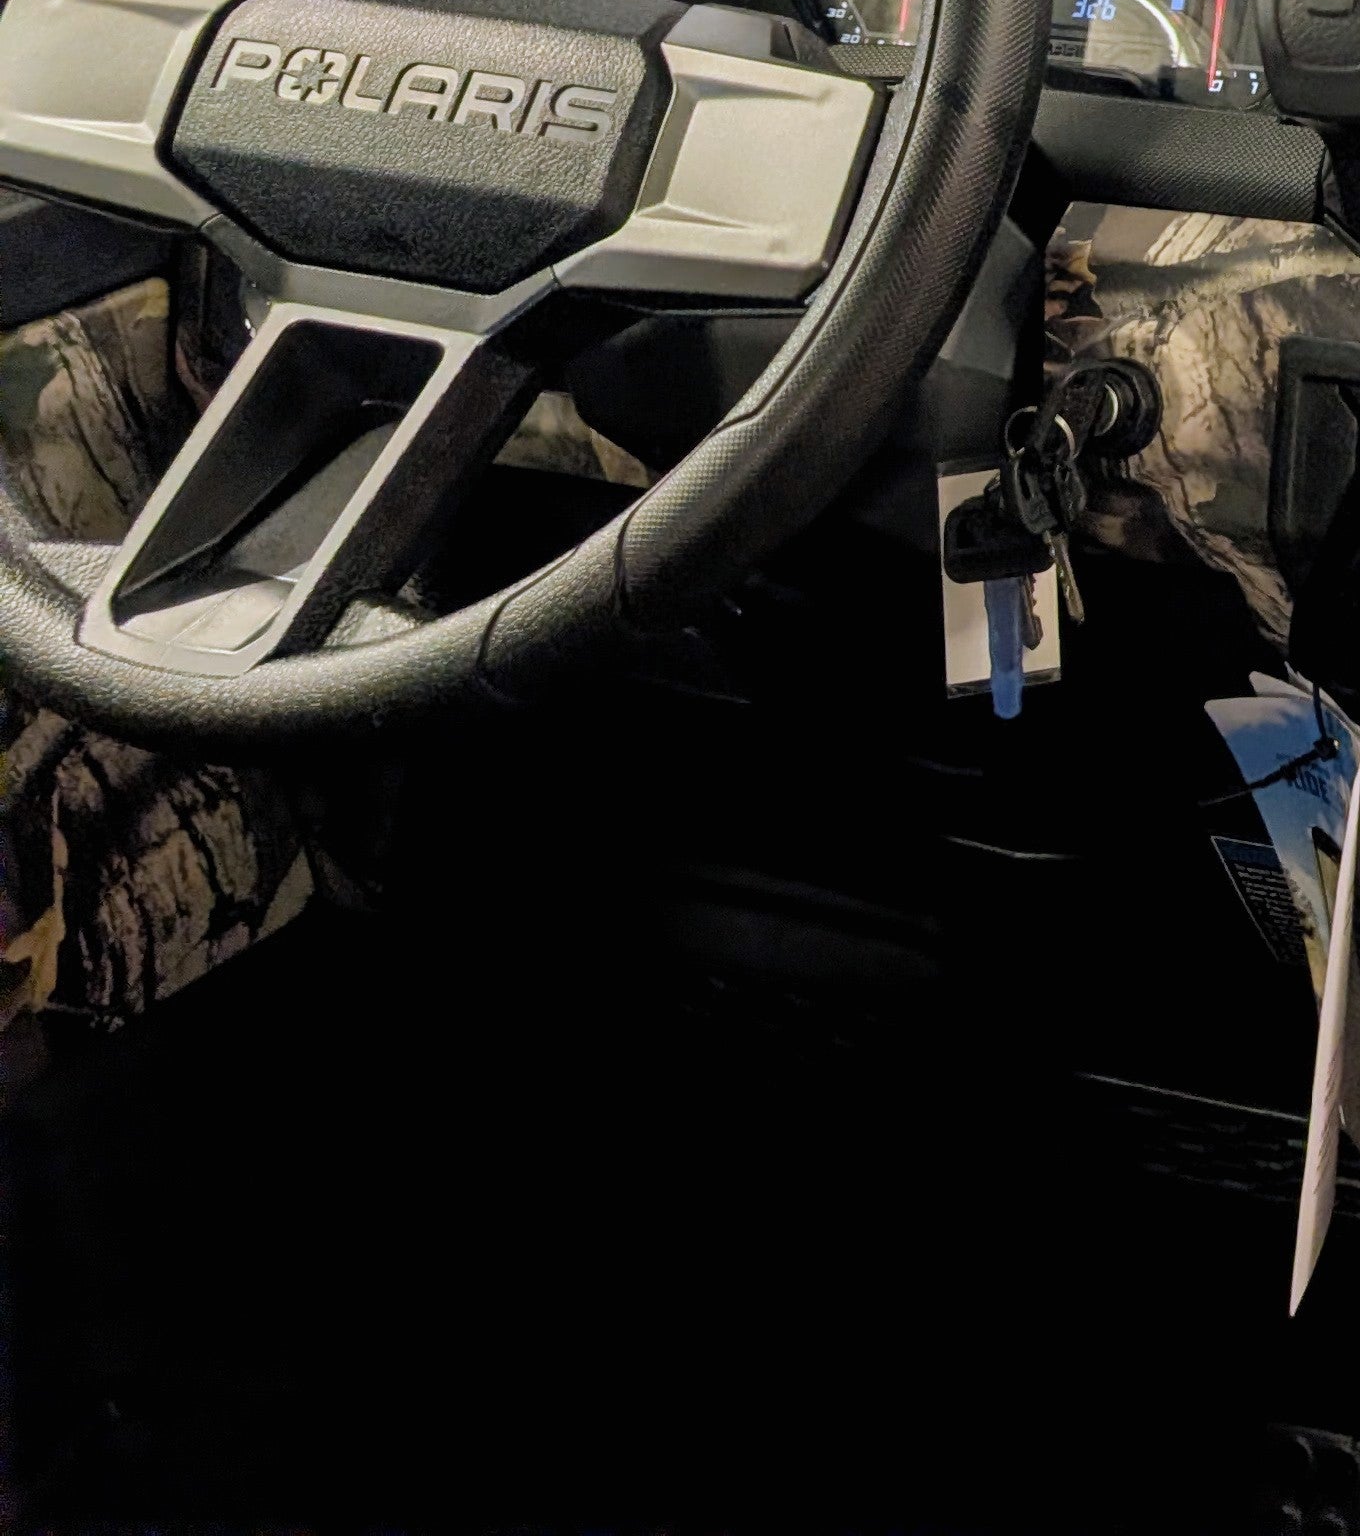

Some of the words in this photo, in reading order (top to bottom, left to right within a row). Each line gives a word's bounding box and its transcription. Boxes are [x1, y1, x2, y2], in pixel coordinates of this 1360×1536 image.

[826, 8, 847, 19] 30
[840, 33, 861, 44] 20
[209, 37, 619, 143] POLARIS
[1250, 81, 1261, 94] 1
